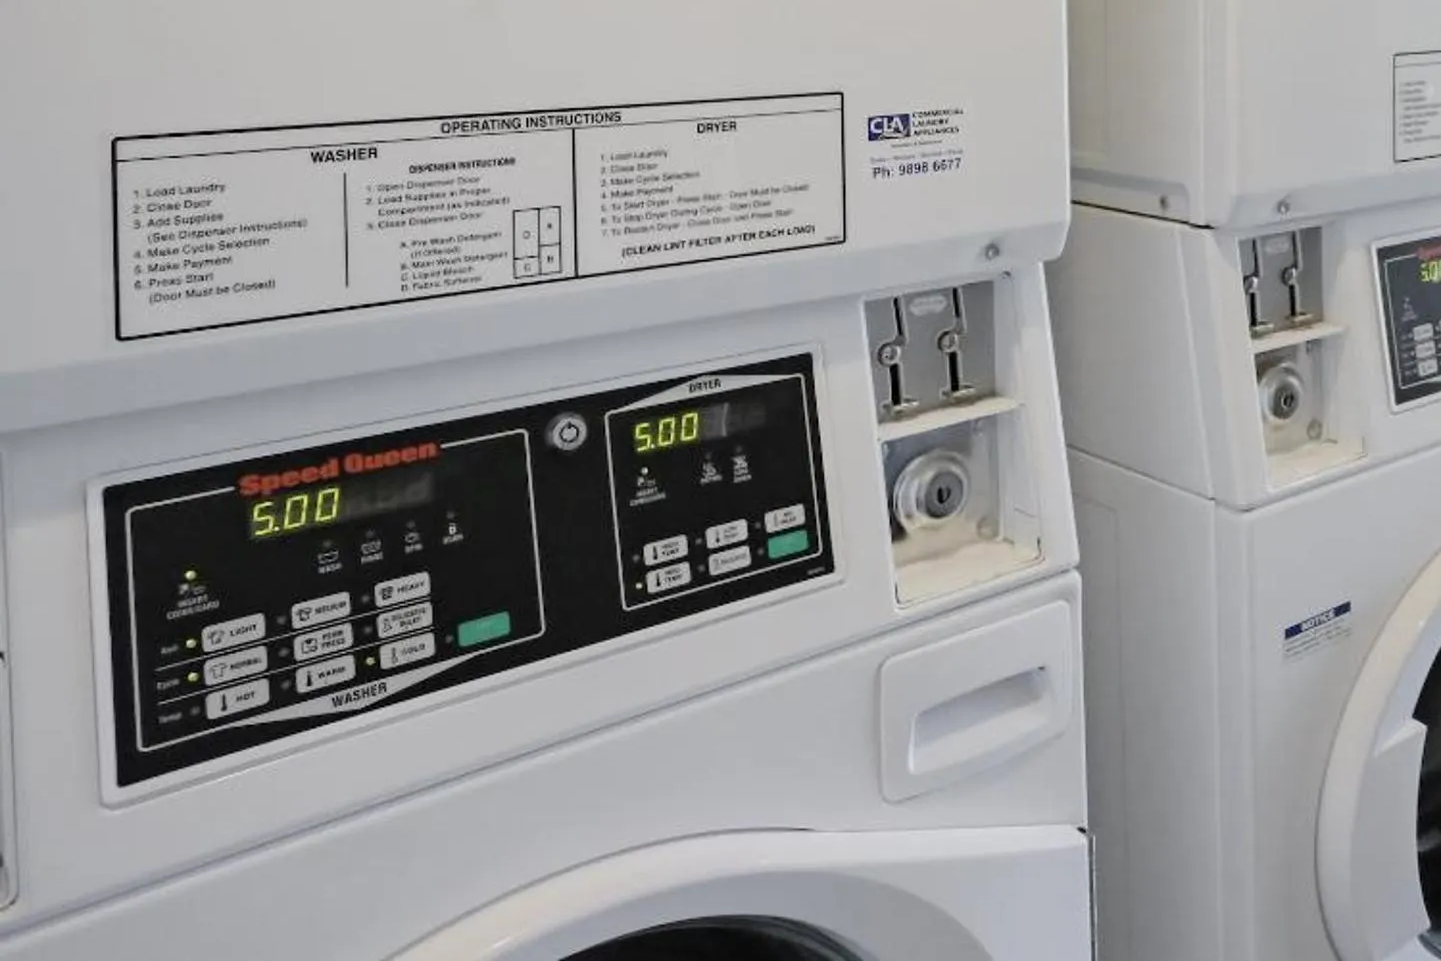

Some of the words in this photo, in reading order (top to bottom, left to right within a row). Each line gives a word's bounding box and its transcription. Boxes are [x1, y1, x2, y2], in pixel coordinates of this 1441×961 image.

[440, 115, 521, 135] OPERATING
[525, 111, 623, 129] INSTRUCTIONS
[696, 121, 737, 134] DRYER
[310, 147, 378, 164] WASHER
[898, 161, 929, 176] 9898
[622, 242, 661, 258] (CLEAN
[663, 240, 685, 251] LINT
[688, 236, 722, 249] FILTER
[725, 232, 756, 244] AFTER
[759, 228, 785, 240] EACH
[688, 378, 721, 393] DRYER
[635, 412, 698, 452] 5.00
[239, 458, 340, 495] Speed
[344, 442, 438, 474] Queen
[252, 487, 340, 536] 5.00
[236, 691, 255, 703] HOT
[331, 682, 388, 707] WASHER
